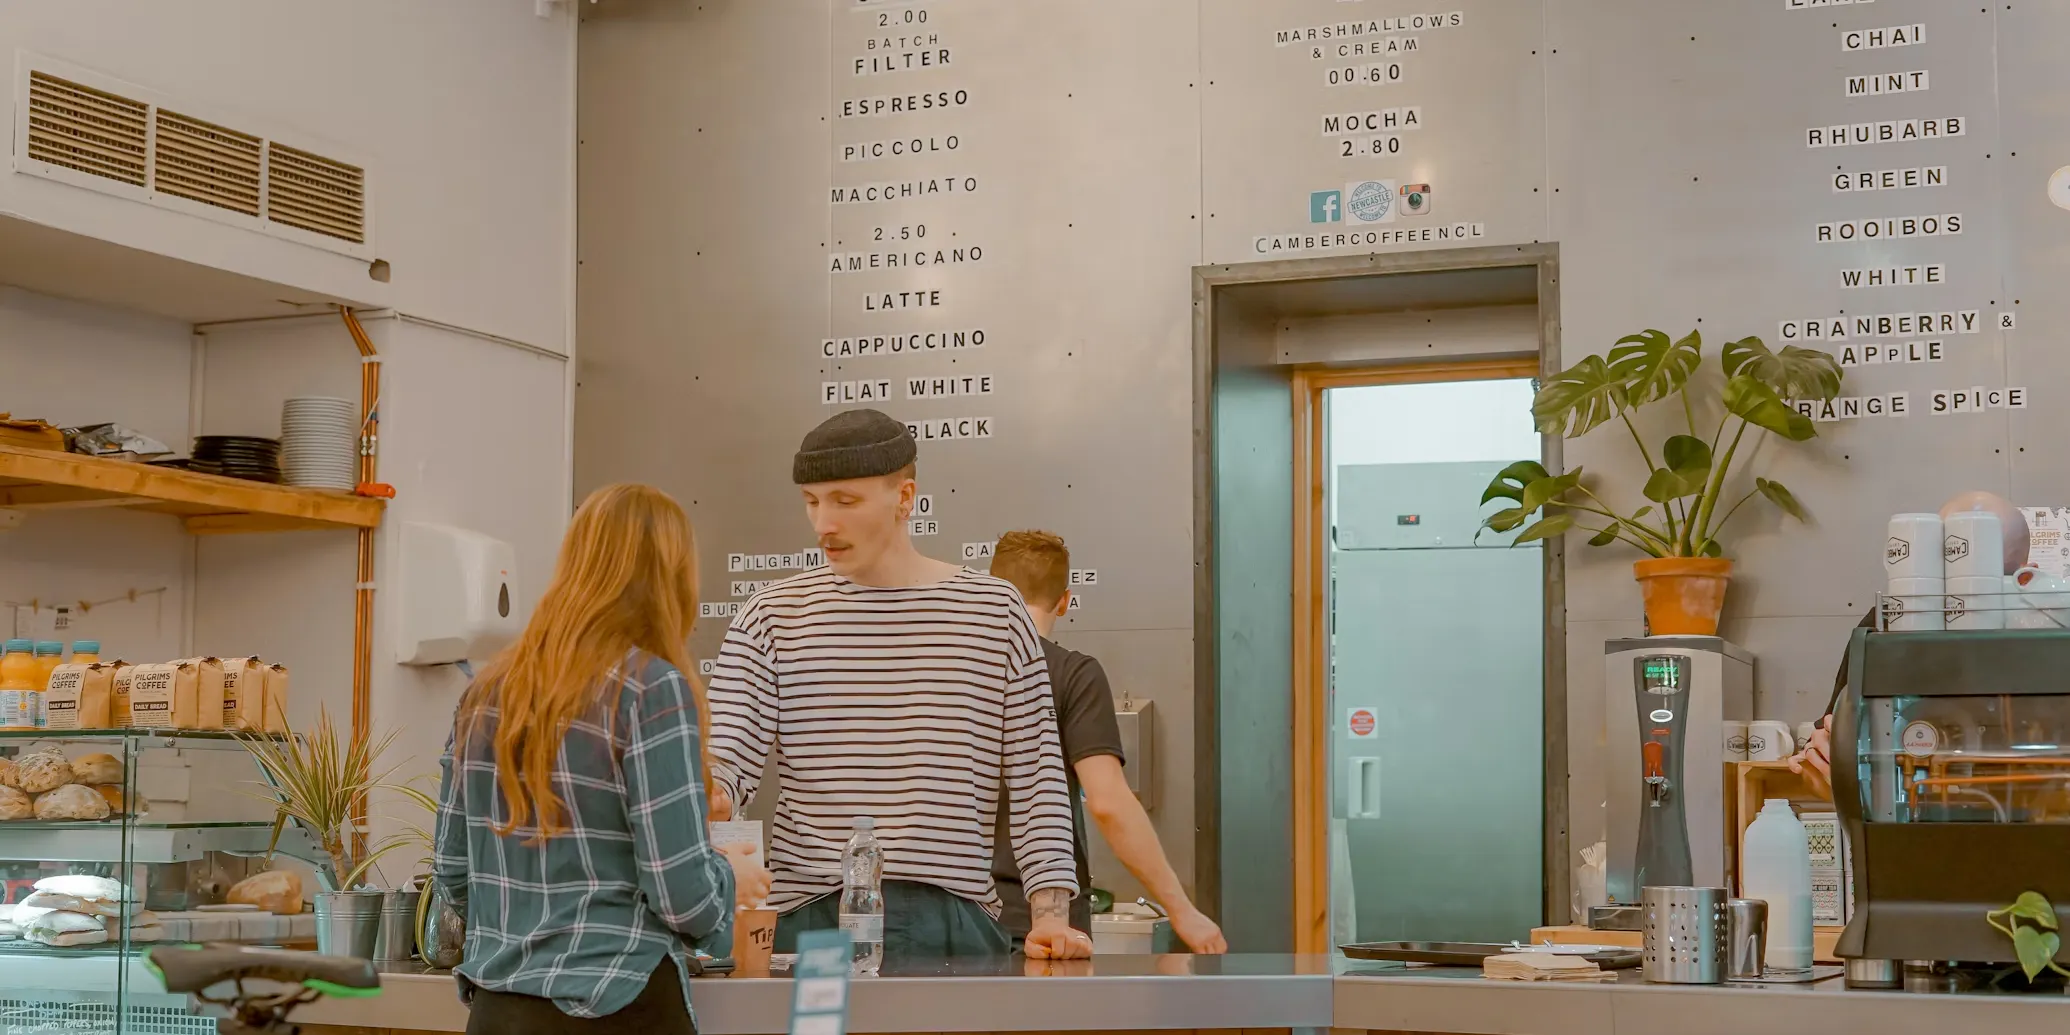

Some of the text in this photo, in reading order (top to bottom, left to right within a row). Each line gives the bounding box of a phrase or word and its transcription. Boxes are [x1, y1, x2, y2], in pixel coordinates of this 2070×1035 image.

[879, 10, 927, 26] 2.00
[1277, 14, 1460, 43] MARSHMALLOWS
[867, 34, 938, 50] BATCH
[1846, 26, 1920, 49] CHAI
[1313, 39, 1417, 59] & CREAM
[855, 49, 950, 74] FILTER
[1329, 64, 1400, 84] 00.60
[1849, 72, 1923, 94] MINT
[843, 90, 968, 116] ESPRESSO
[1324, 110, 1417, 133] MOCHA
[1808, 118, 1960, 144] RHUBARB
[844, 136, 959, 160] PICCOLO
[1342, 137, 1400, 157] 2.80
[831, 177, 977, 202] MACCHIATO
[1835, 168, 1942, 190] GREEN
[1351, 192, 1390, 211] NEWCASTLE
[874, 225, 926, 240] 2.50
[1256, 225, 1481, 253] CAMBERCOFFEENCL
[1818, 216, 1960, 241] ROOIBOS
[831, 247, 982, 271] AMERICANO
[1842, 266, 1940, 287] WHITE
[866, 291, 940, 310] LATTE
[1783, 313, 2013, 337] CRANBERRY &
[823, 330, 985, 356] CAPPUCCINO
[1841, 342, 1942, 364] APPLE
[826, 377, 991, 400] FLAT WHITE
[1799, 390, 2022, 418] RANGE SPICE
[908, 420, 989, 439] BLACK
[2031, 538, 2059, 546] OFFEE
[731, 553, 818, 569] PILGRIM
[703, 604, 738, 615] BUR
[51, 672, 81, 681] PILGRIMS
[51, 681, 77, 689] COFFEE
[135, 672, 171, 681] PILGRIMS
[136, 681, 167, 690] COFFEE
